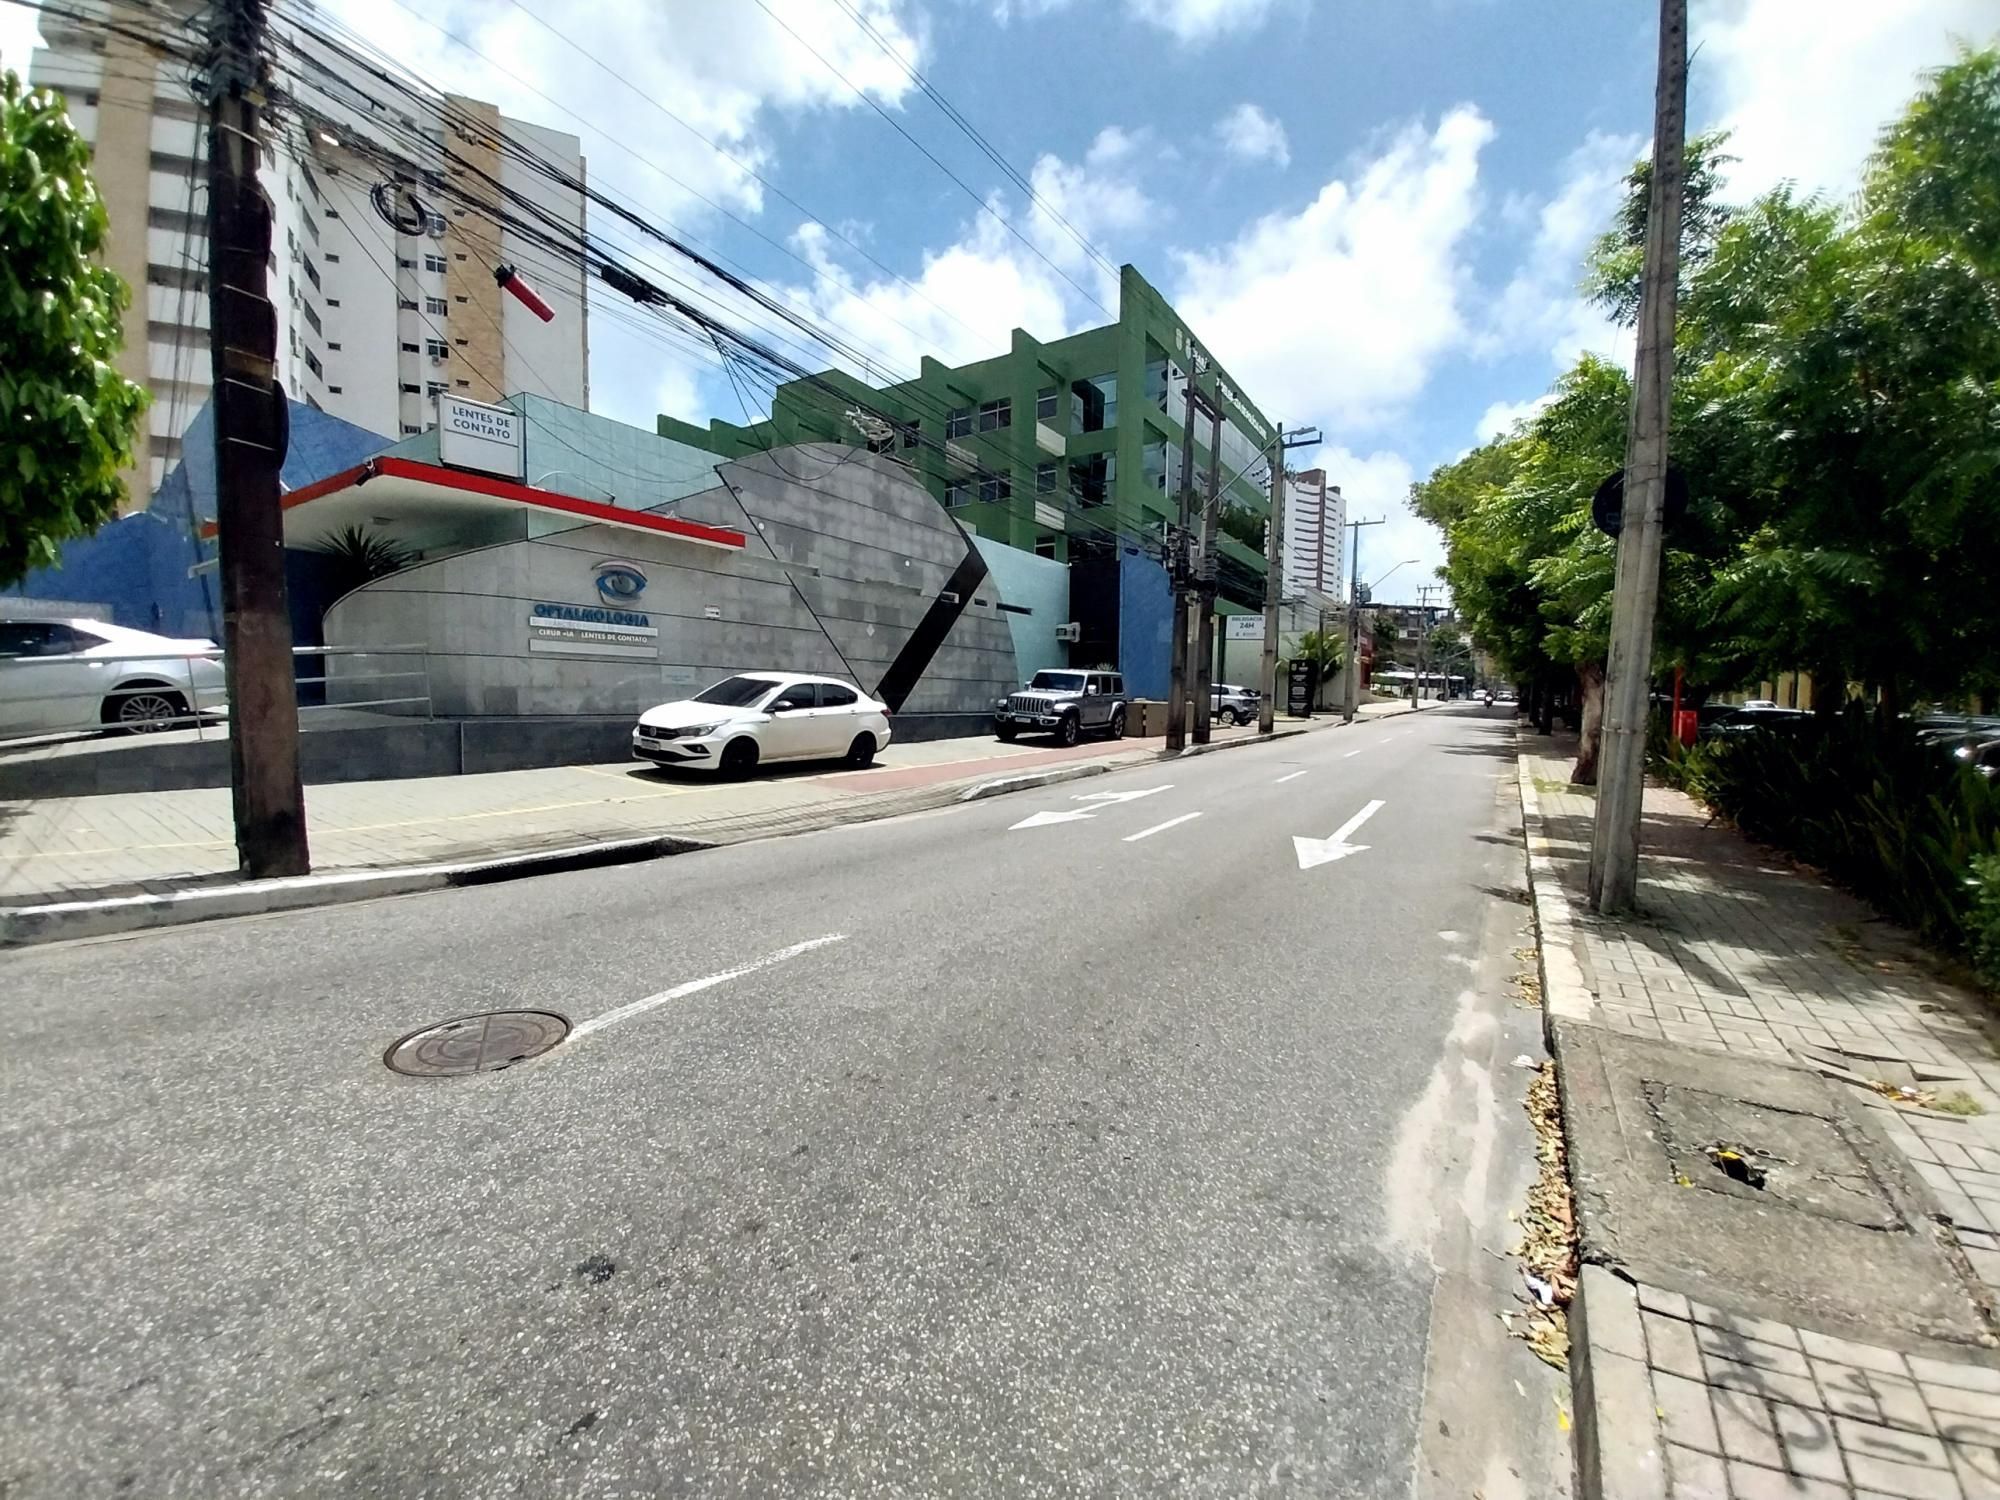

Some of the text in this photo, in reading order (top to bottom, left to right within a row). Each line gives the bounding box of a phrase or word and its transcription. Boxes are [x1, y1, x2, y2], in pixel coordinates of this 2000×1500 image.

[452, 406, 511, 428] LENTES DE
[453, 418, 511, 439] CONTATO
[581, 631, 606, 640] LENTES
[617, 635, 648, 643] CONTATO
